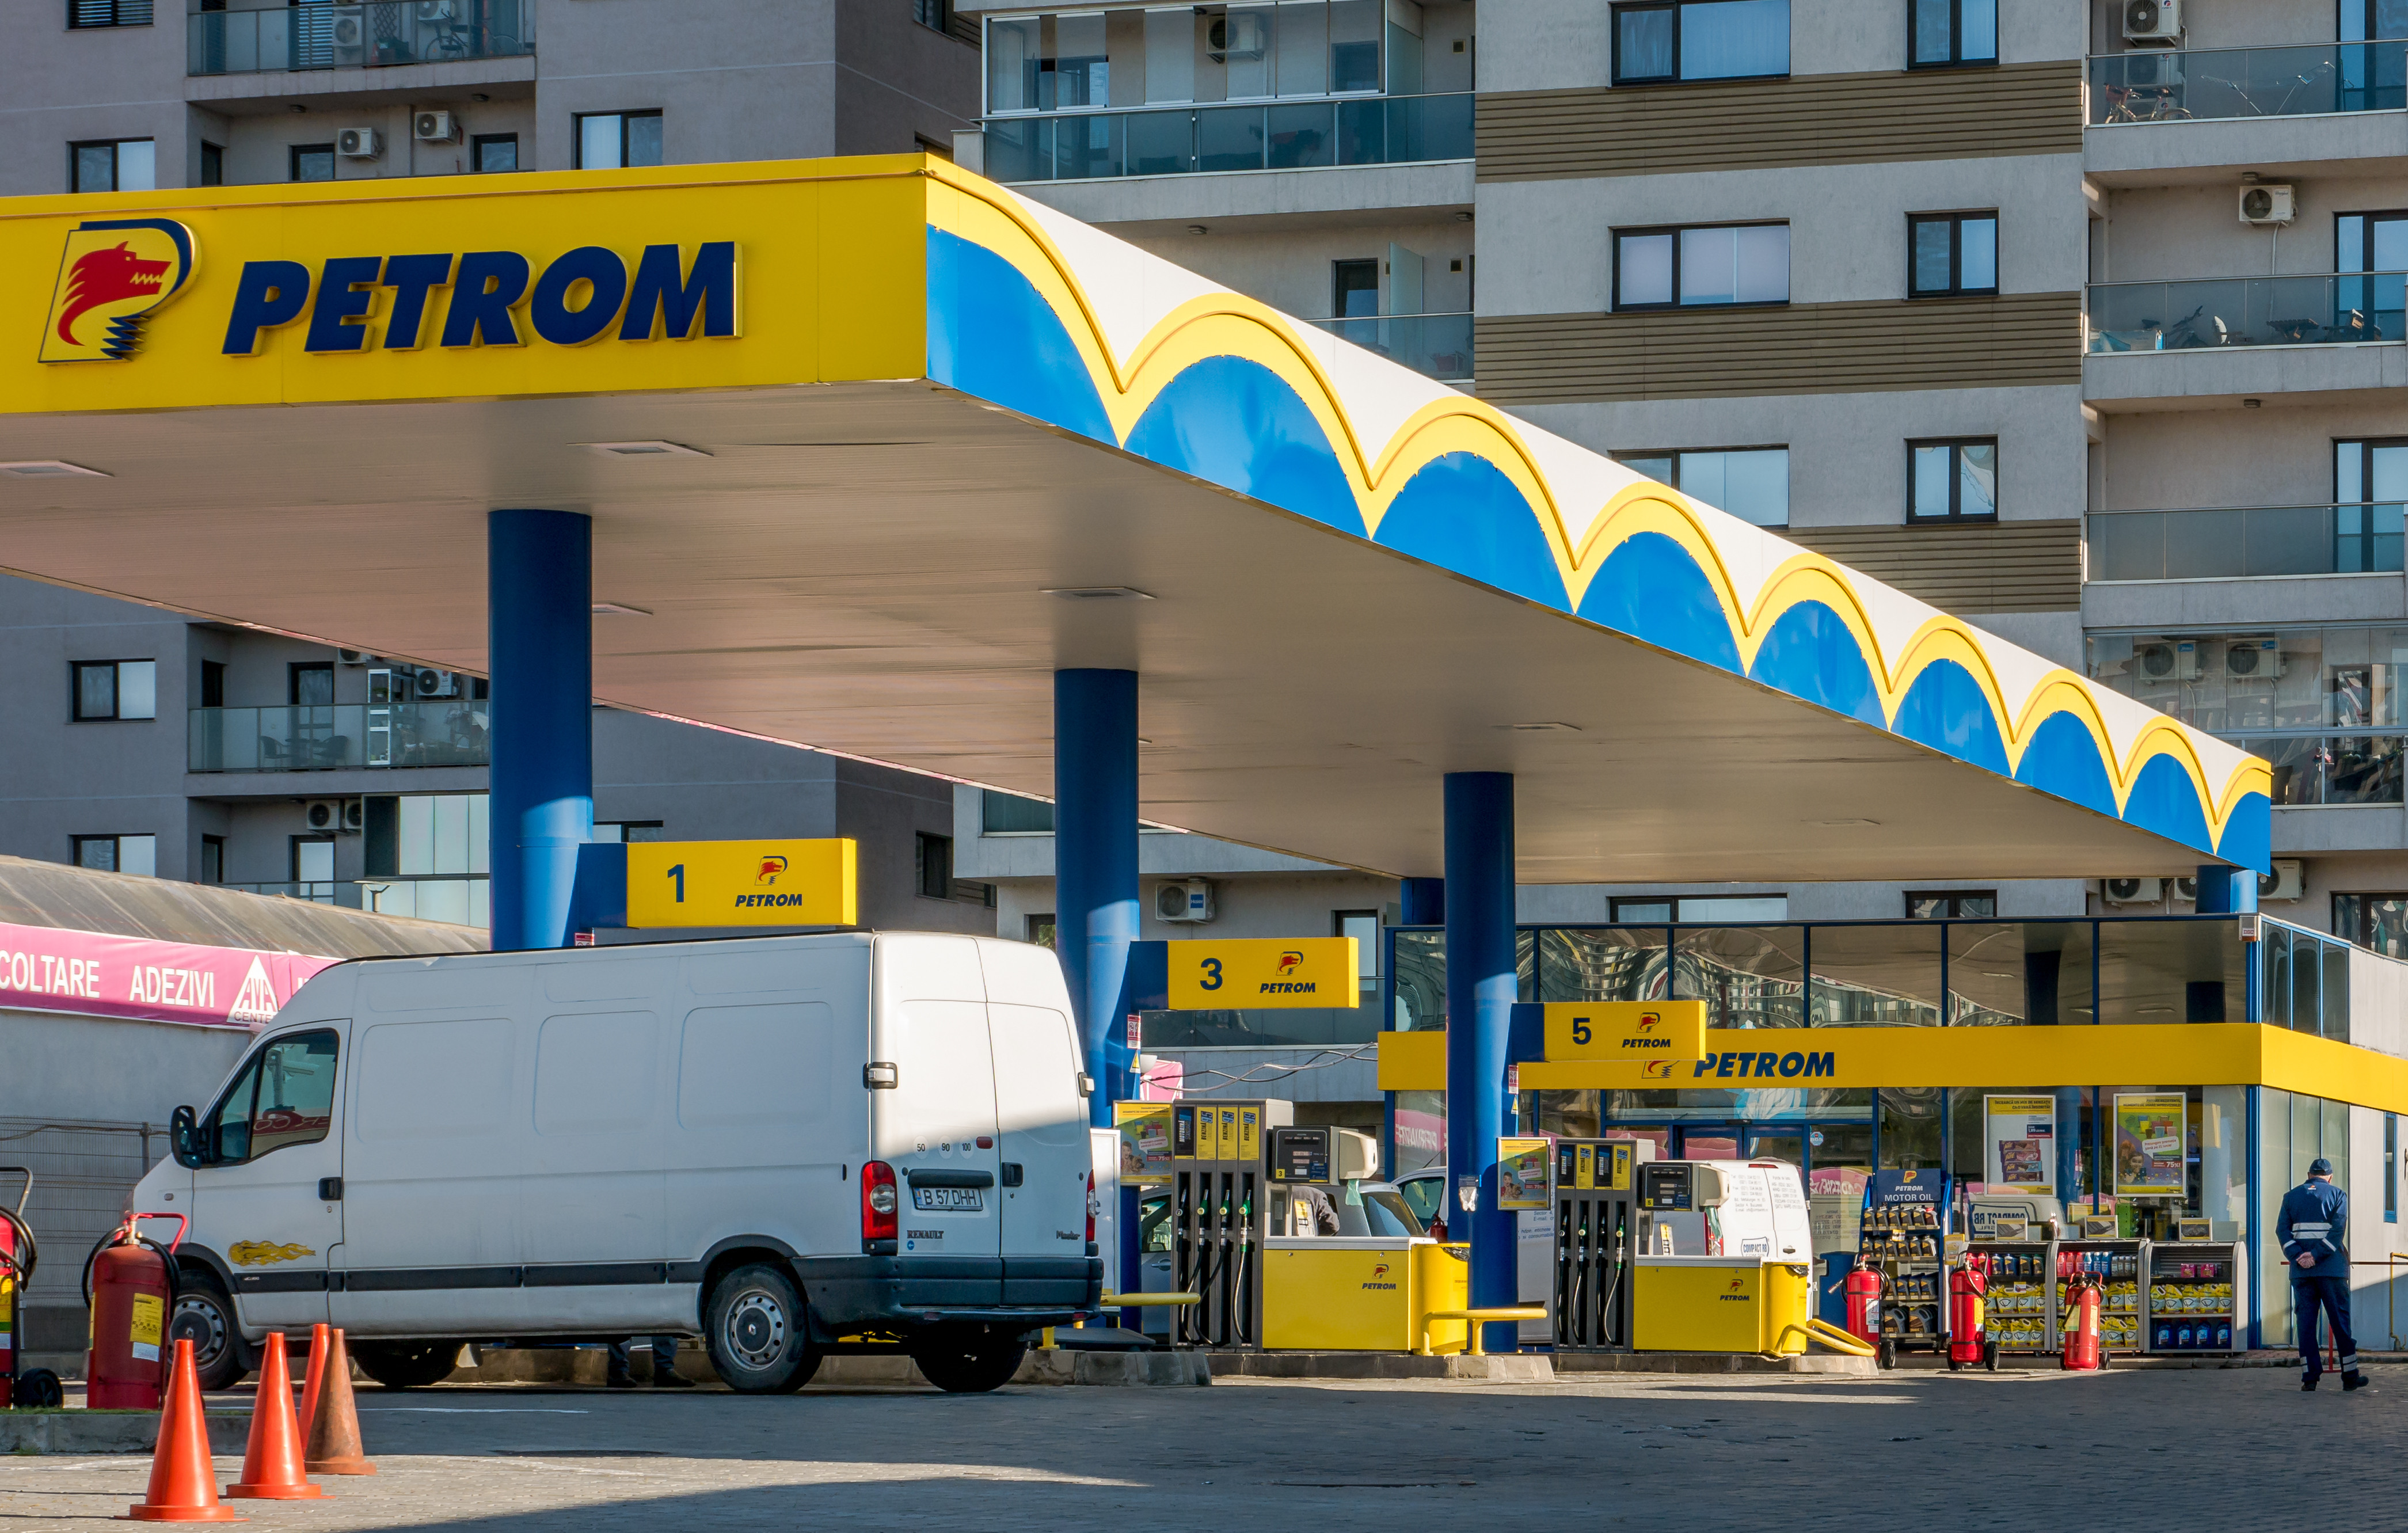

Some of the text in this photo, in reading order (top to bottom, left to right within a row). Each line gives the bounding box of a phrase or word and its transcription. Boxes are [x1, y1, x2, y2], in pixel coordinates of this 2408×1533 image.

[222, 242, 742, 356] PETROM
[667, 864, 684, 903] 1
[735, 893, 802, 907] PETROM
[1200, 958, 1223, 990] 3
[129, 965, 214, 1008] ADEZIVI
[1260, 983, 1315, 993] PETROM
[234, 1011, 275, 1024] CENTE
[1572, 1018, 1591, 1045] 5
[1622, 1039, 1671, 1048] PETROM
[1693, 1052, 1835, 1078] PETROM
[942, 1143, 950, 1151] 90
[923, 1189, 976, 1205] B 57 DHH
[907, 1230, 944, 1239] RENAULT
[1743, 1244, 1767, 1253] COMPACT RB
